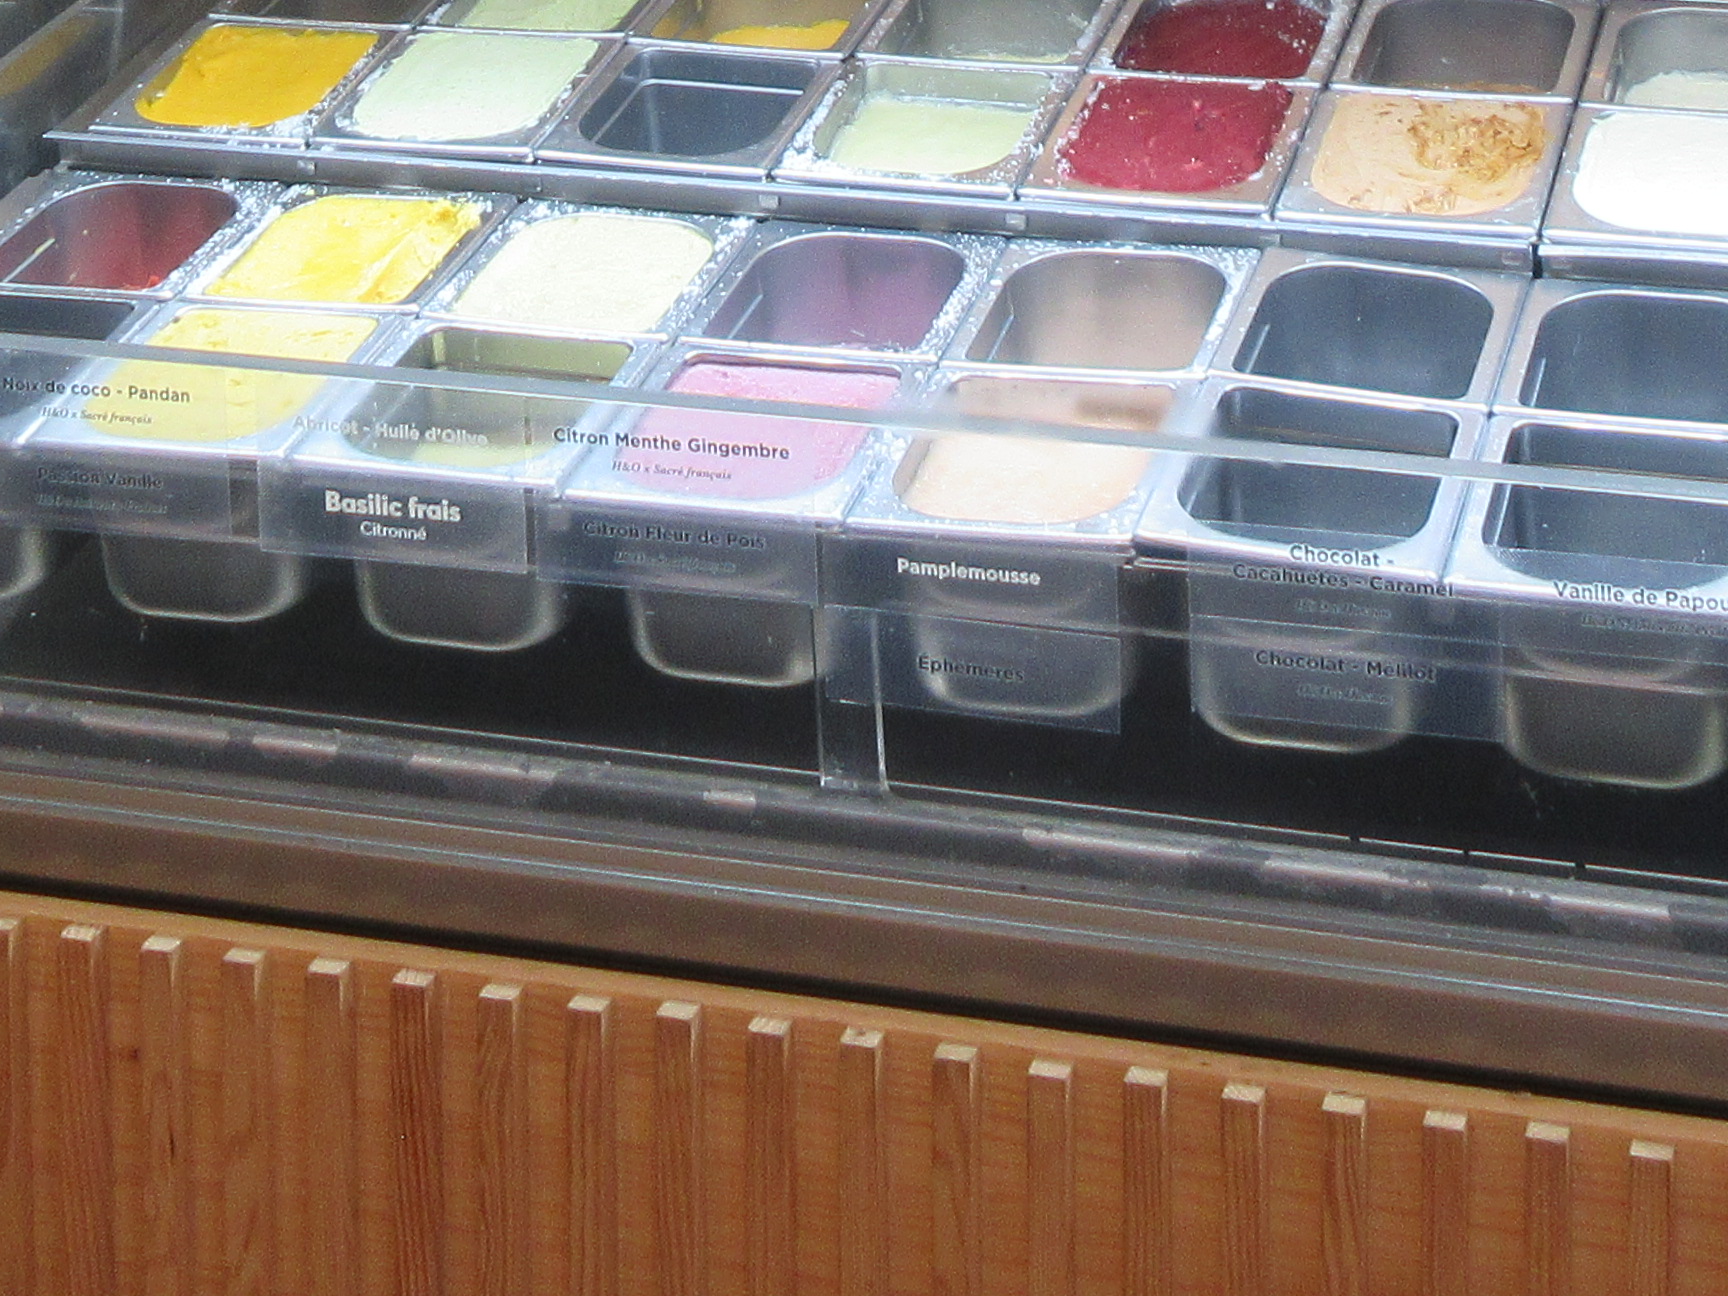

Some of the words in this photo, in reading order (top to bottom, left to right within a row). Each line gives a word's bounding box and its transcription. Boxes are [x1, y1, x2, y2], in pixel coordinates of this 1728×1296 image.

[2, 377, 40, 393] Noix
[45, 380, 67, 395] de
[71, 382, 111, 397] coco
[128, 385, 190, 403] Pandan
[108, 410, 153, 426] français
[294, 415, 358, 436] Abricot
[553, 426, 609, 446] Citron
[615, 431, 682, 452] Menthe
[687, 437, 791, 460] Gingembre
[612, 460, 640, 473] H&O
[684, 464, 733, 481] français
[324, 488, 404, 519] Basilic
[407, 495, 462, 523] frais
[360, 518, 428, 542] Citronné
[583, 520, 641, 540] Citron
[645, 525, 692, 544] Fleur
[697, 529, 721, 546] de
[726, 532, 767, 550] Pois
[1289, 542, 1379, 567] Chocolat
[897, 557, 1041, 587] Pamplemousse
[1369, 575, 1454, 598] Caramel
[1553, 580, 1625, 605] Vanille
[1631, 586, 1658, 608] de
[1255, 649, 1345, 673] Chocolat
